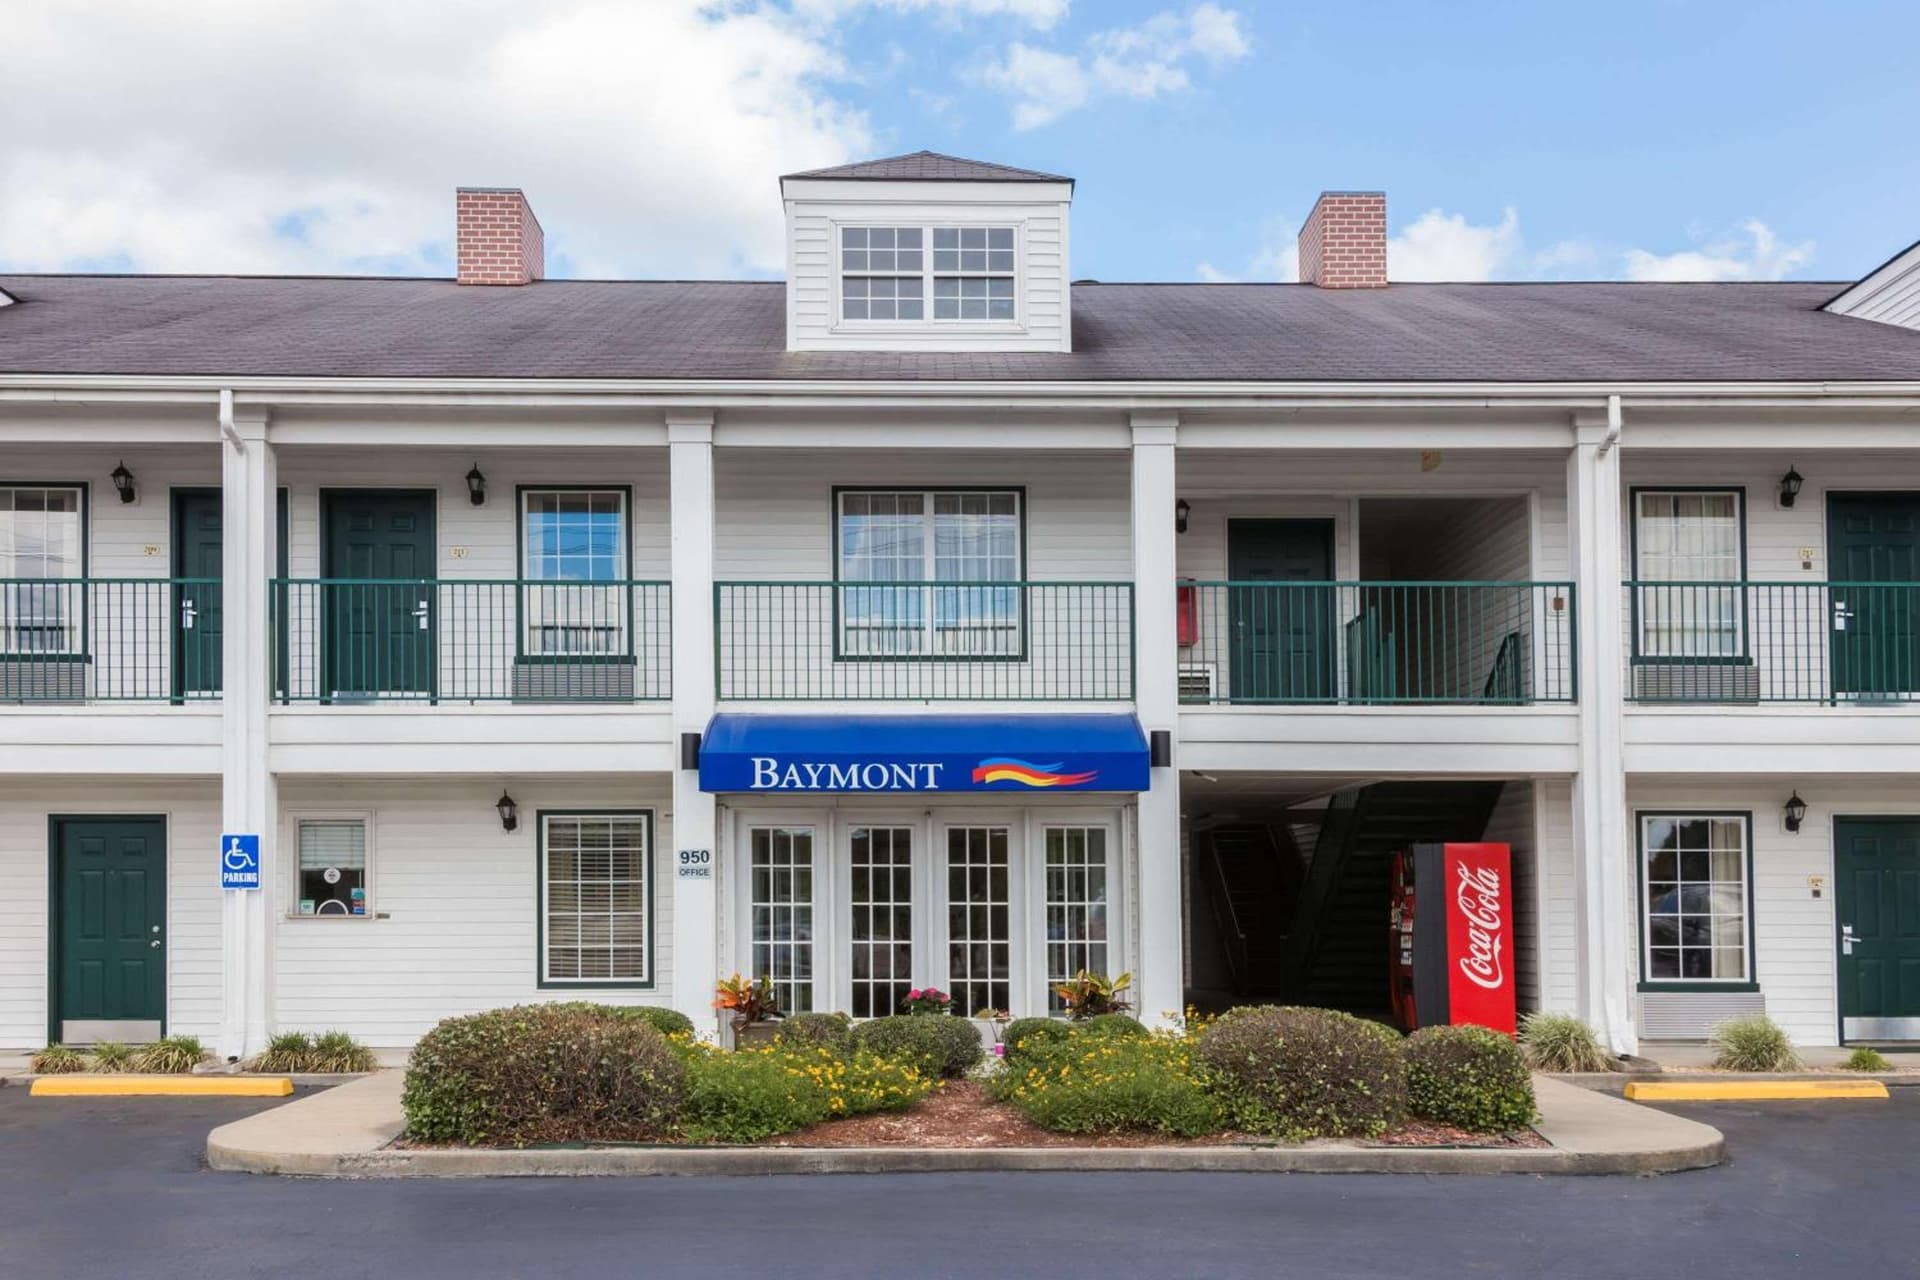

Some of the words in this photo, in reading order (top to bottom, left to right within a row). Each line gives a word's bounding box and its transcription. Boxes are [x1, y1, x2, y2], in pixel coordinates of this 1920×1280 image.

[750, 758, 943, 789] BAYMONT
[680, 850, 710, 864] 950
[223, 872, 258, 883] PARKING
[679, 868, 710, 876] OFFICE
[1457, 860, 1503, 989] Coca-Cola
